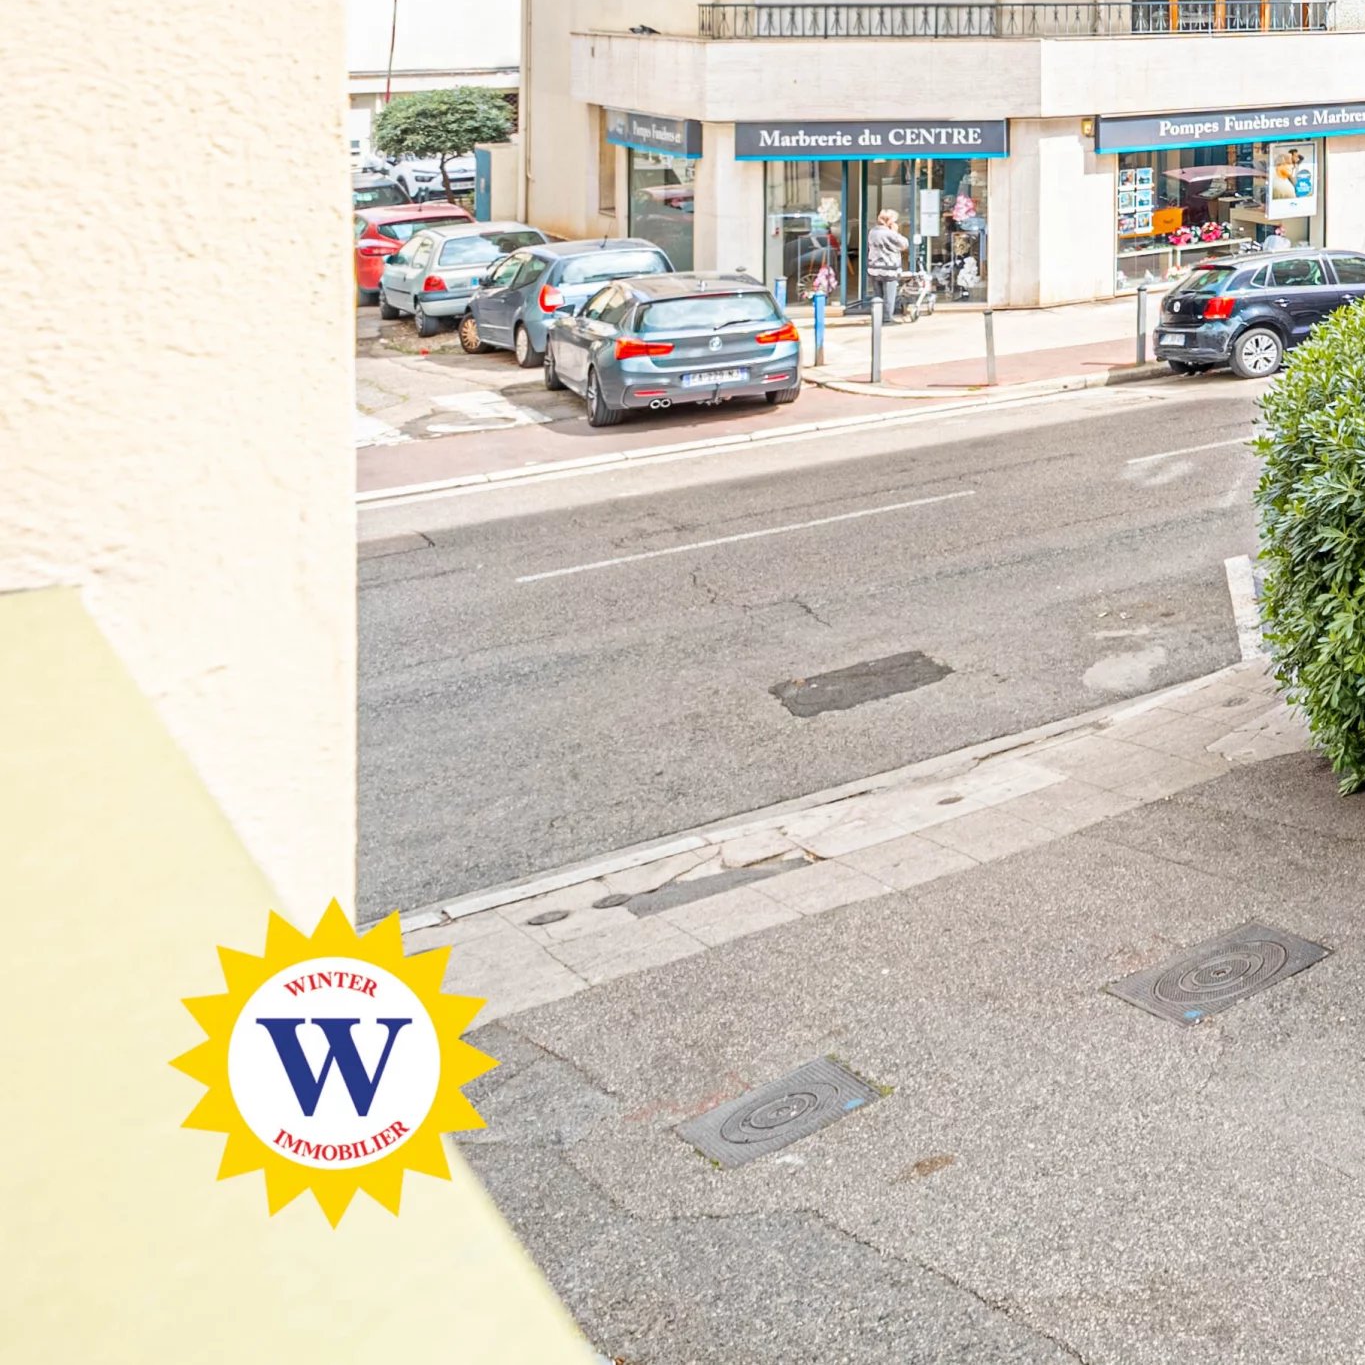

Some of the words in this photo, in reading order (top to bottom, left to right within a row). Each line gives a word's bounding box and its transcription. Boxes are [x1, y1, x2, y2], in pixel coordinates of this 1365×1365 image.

[1159, 120, 1219, 138] Pompes
[1224, 113, 1290, 131] Funèbres
[1294, 114, 1308, 126] et
[759, 129, 852, 147] Marbrerie
[858, 129, 882, 146] du
[888, 127, 981, 145] CENTRE
